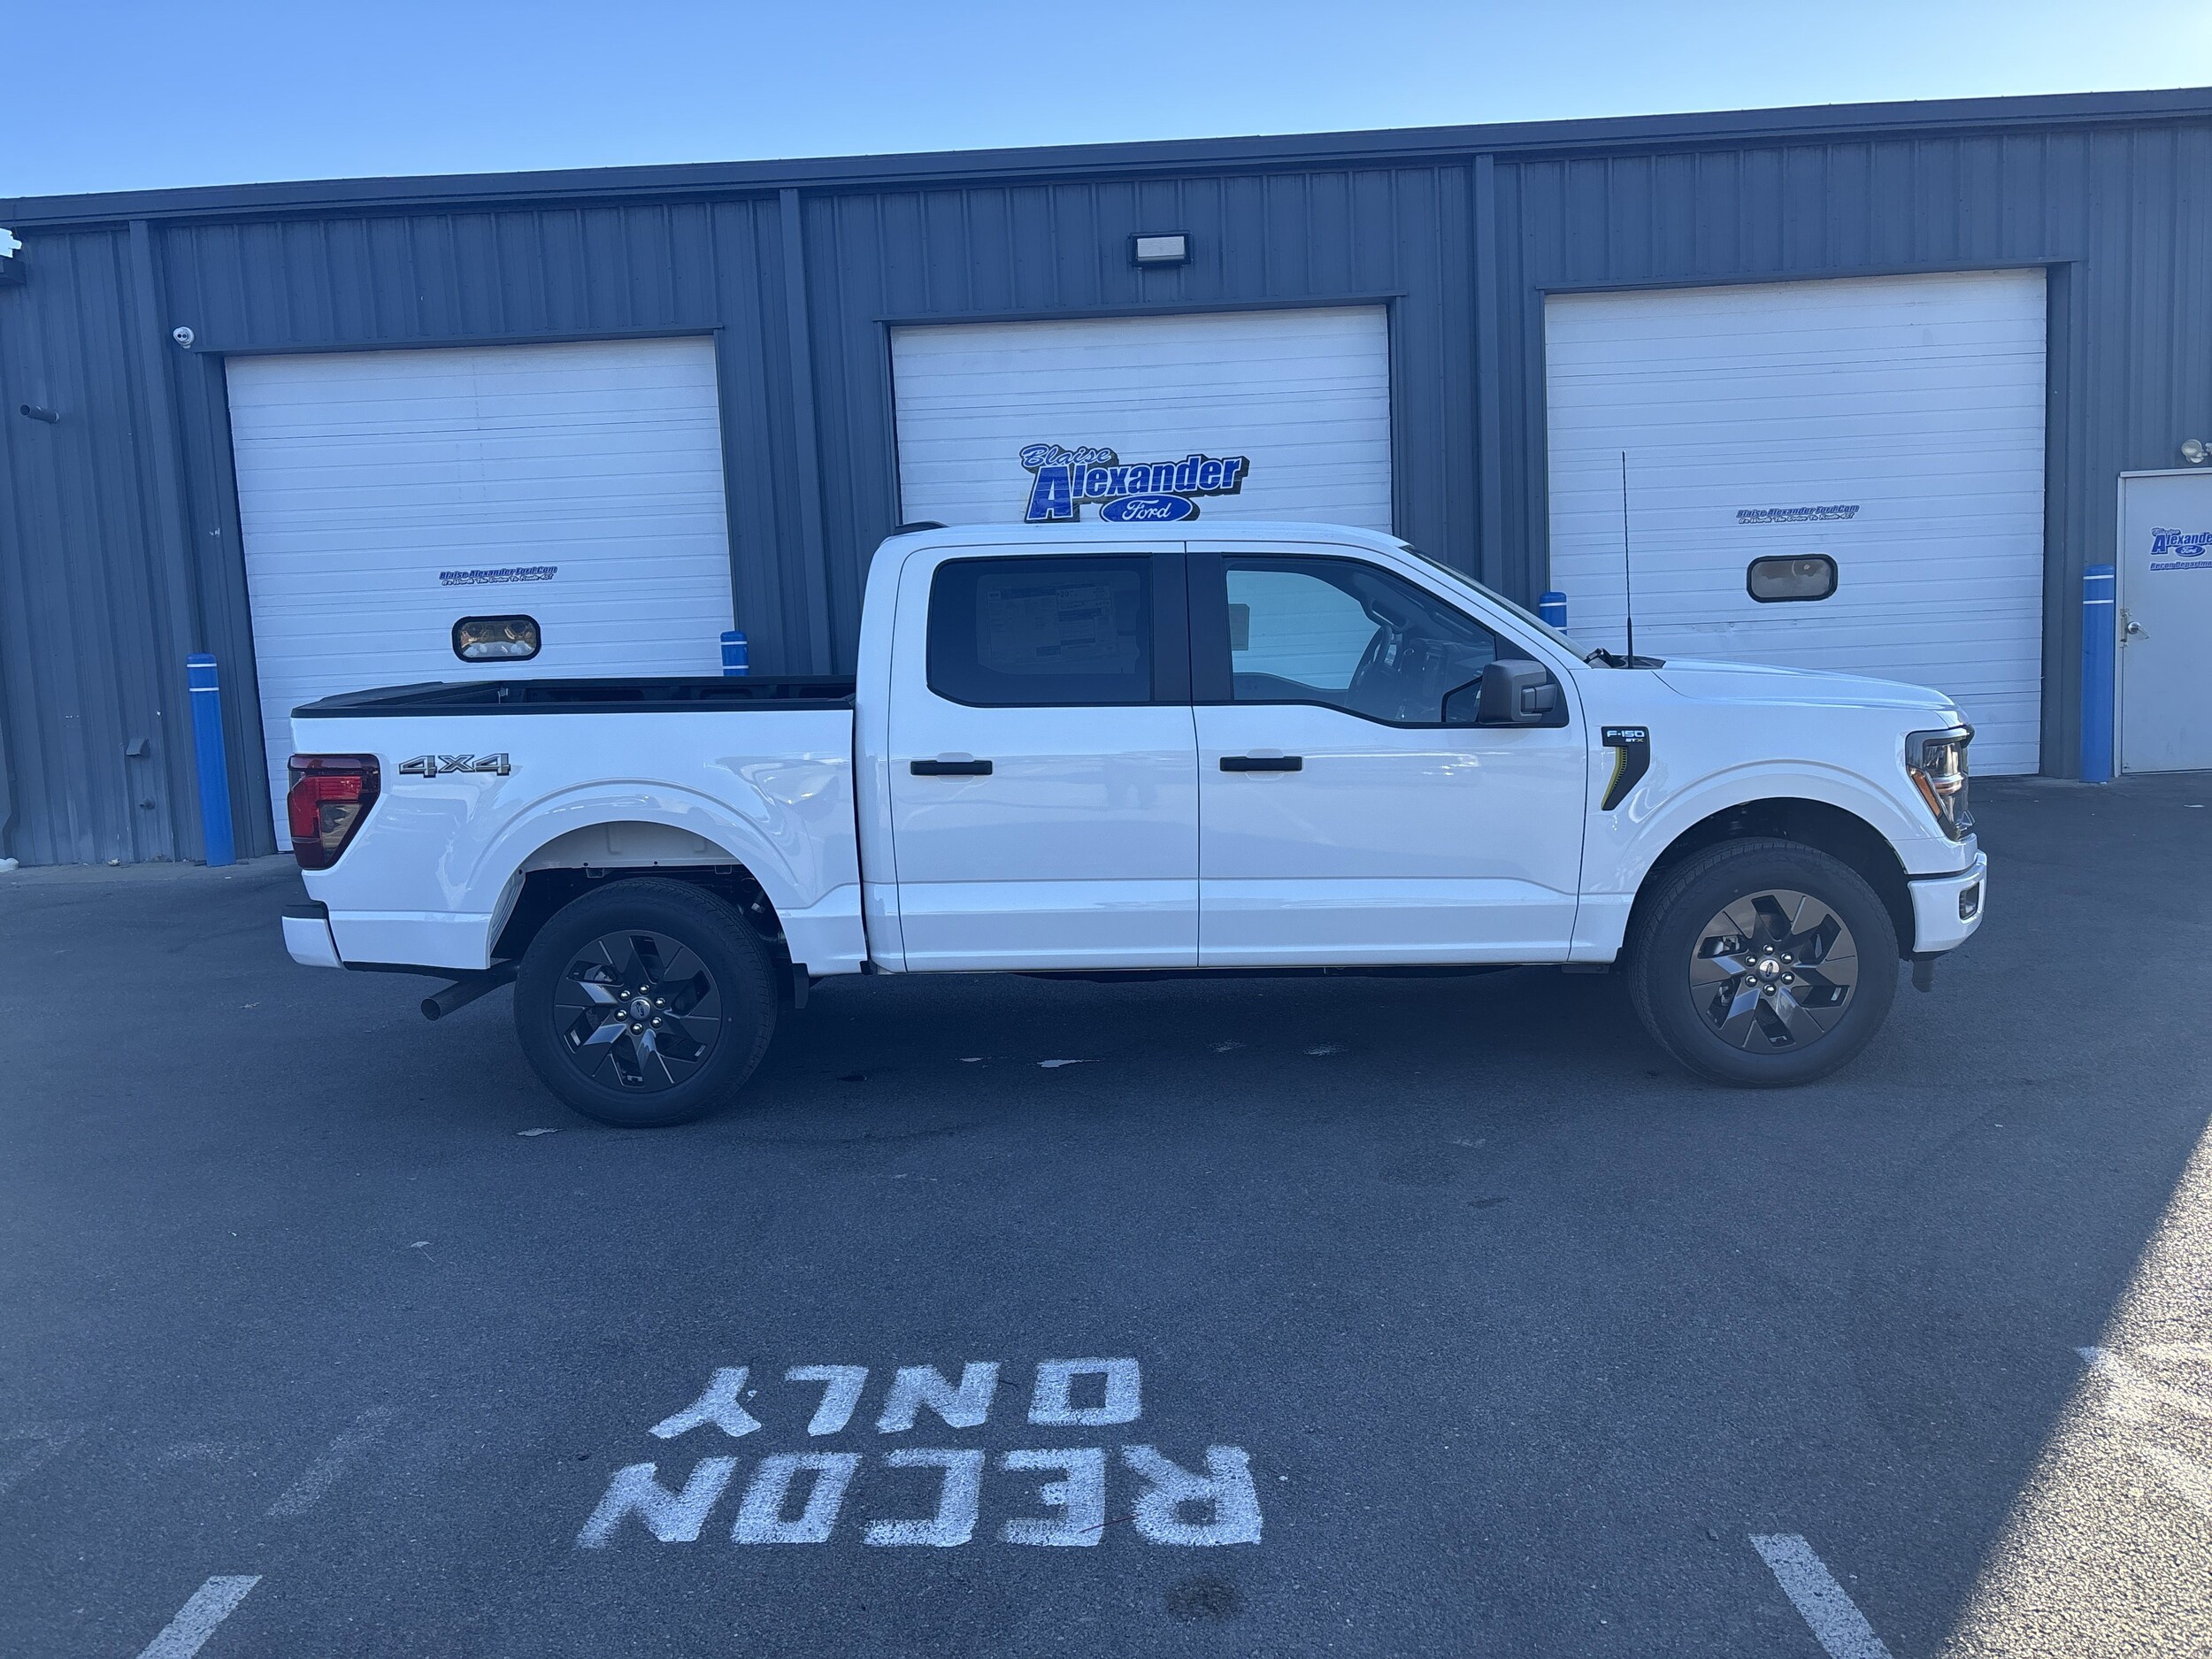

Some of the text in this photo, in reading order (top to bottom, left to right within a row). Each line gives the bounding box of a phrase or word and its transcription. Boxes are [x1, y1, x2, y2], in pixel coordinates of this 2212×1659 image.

[1021, 443, 1113, 468] Blaise
[1025, 455, 1246, 520] Alexander
[1121, 499, 1172, 520] Ford
[2152, 533, 2212, 554] Alexande
[649, 1357, 1143, 1439] ONLY
[577, 1445, 1263, 1548] RECON
